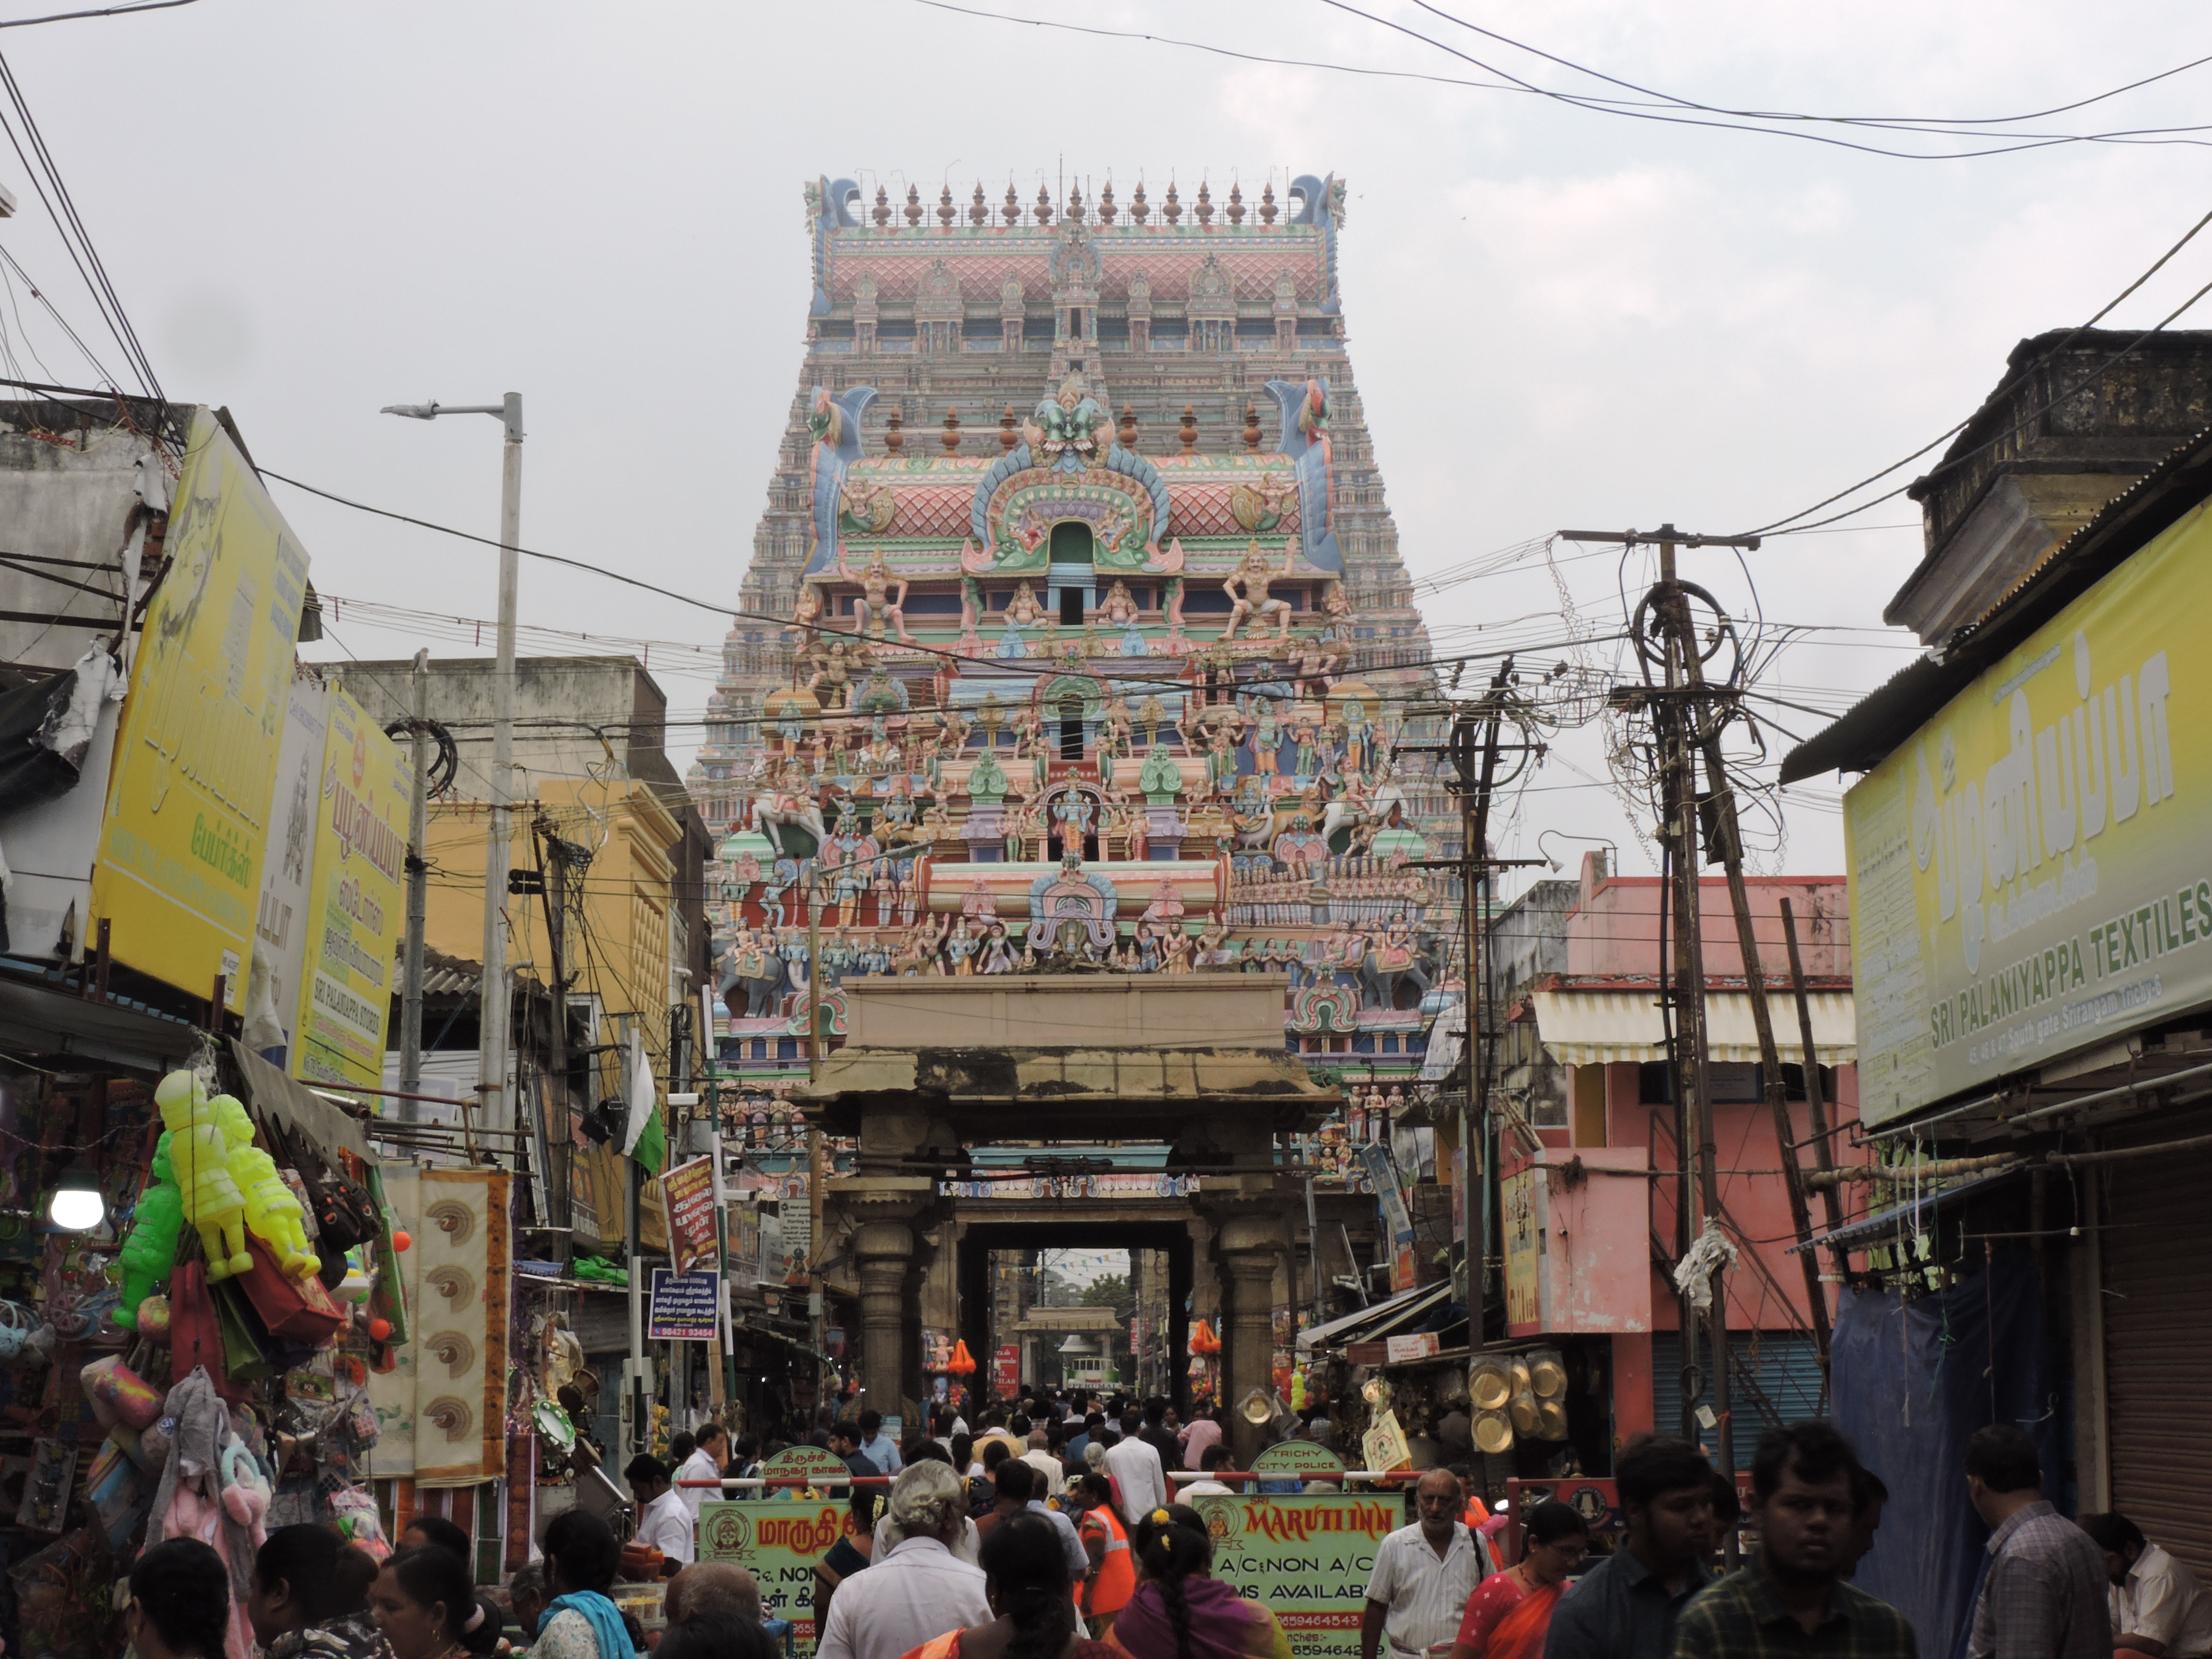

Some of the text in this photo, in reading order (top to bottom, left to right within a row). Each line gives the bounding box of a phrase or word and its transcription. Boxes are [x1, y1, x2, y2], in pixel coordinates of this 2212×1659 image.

[1930, 878, 2212, 1051] SRI PALANIYAPPA TEXTILES
[688, 1328, 713, 1336] 93454
[780, 1451, 827, 1465] திருச்சி
[1270, 1449, 1322, 1458] TRICHY
[764, 1463, 847, 1477] மாநகர காவல்
[1242, 1500, 1396, 1544] MARUTI INN
[757, 1506, 838, 1556] மாருதி
[1219, 1553, 1258, 1578] A/C
[1266, 1557, 1319, 1573] NON
[1329, 1552, 1373, 1577] A/C
[1269, 1584, 1368, 1599] AVAILAB
[1287, 1631, 1327, 1642] nches:-
[1292, 1645, 1385, 1656] 65946429
